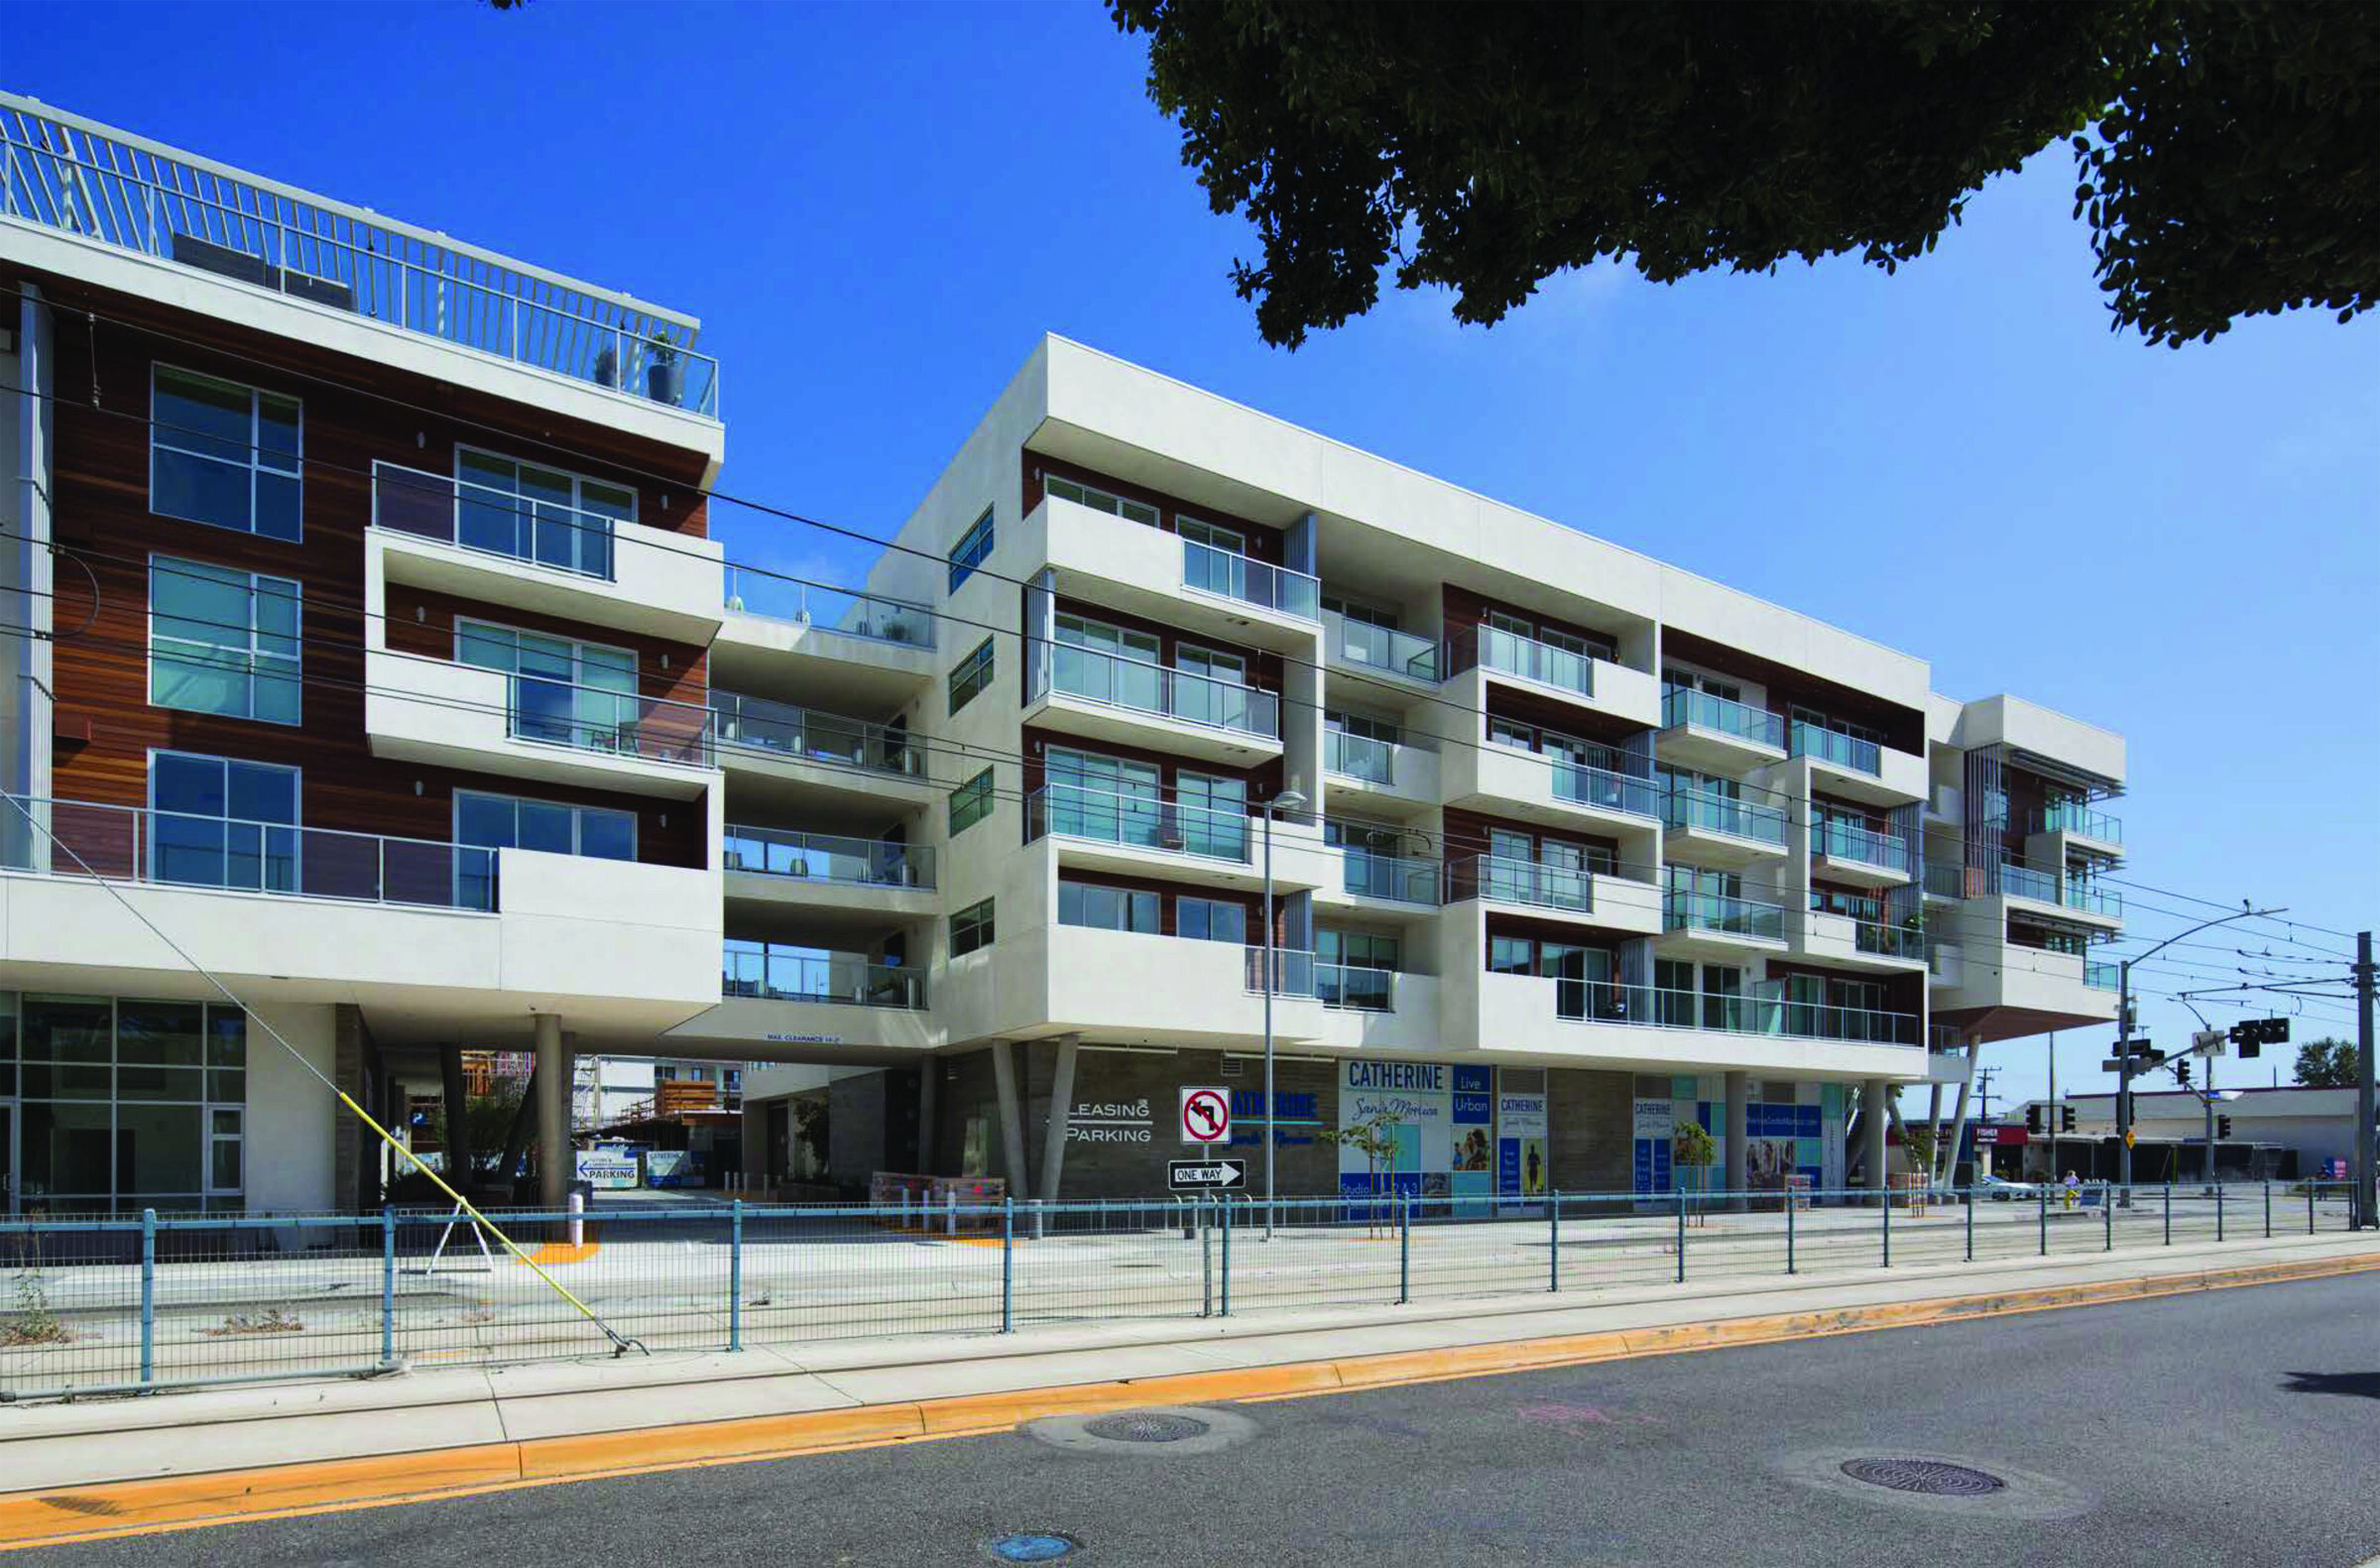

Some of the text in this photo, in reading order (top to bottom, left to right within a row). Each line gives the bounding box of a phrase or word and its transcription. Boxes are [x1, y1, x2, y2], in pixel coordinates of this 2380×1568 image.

[1349, 1062, 1443, 1090] CATHERINE
[1461, 1075, 1482, 1090] Live
[1455, 1096, 1488, 1112] Urban
[1501, 1099, 1543, 1112] CATHERINE
[1065, 1128, 1150, 1143] PARKING
[589, 1170, 636, 1179] PARKING
[1177, 1169, 1223, 1180] ONE WAY
